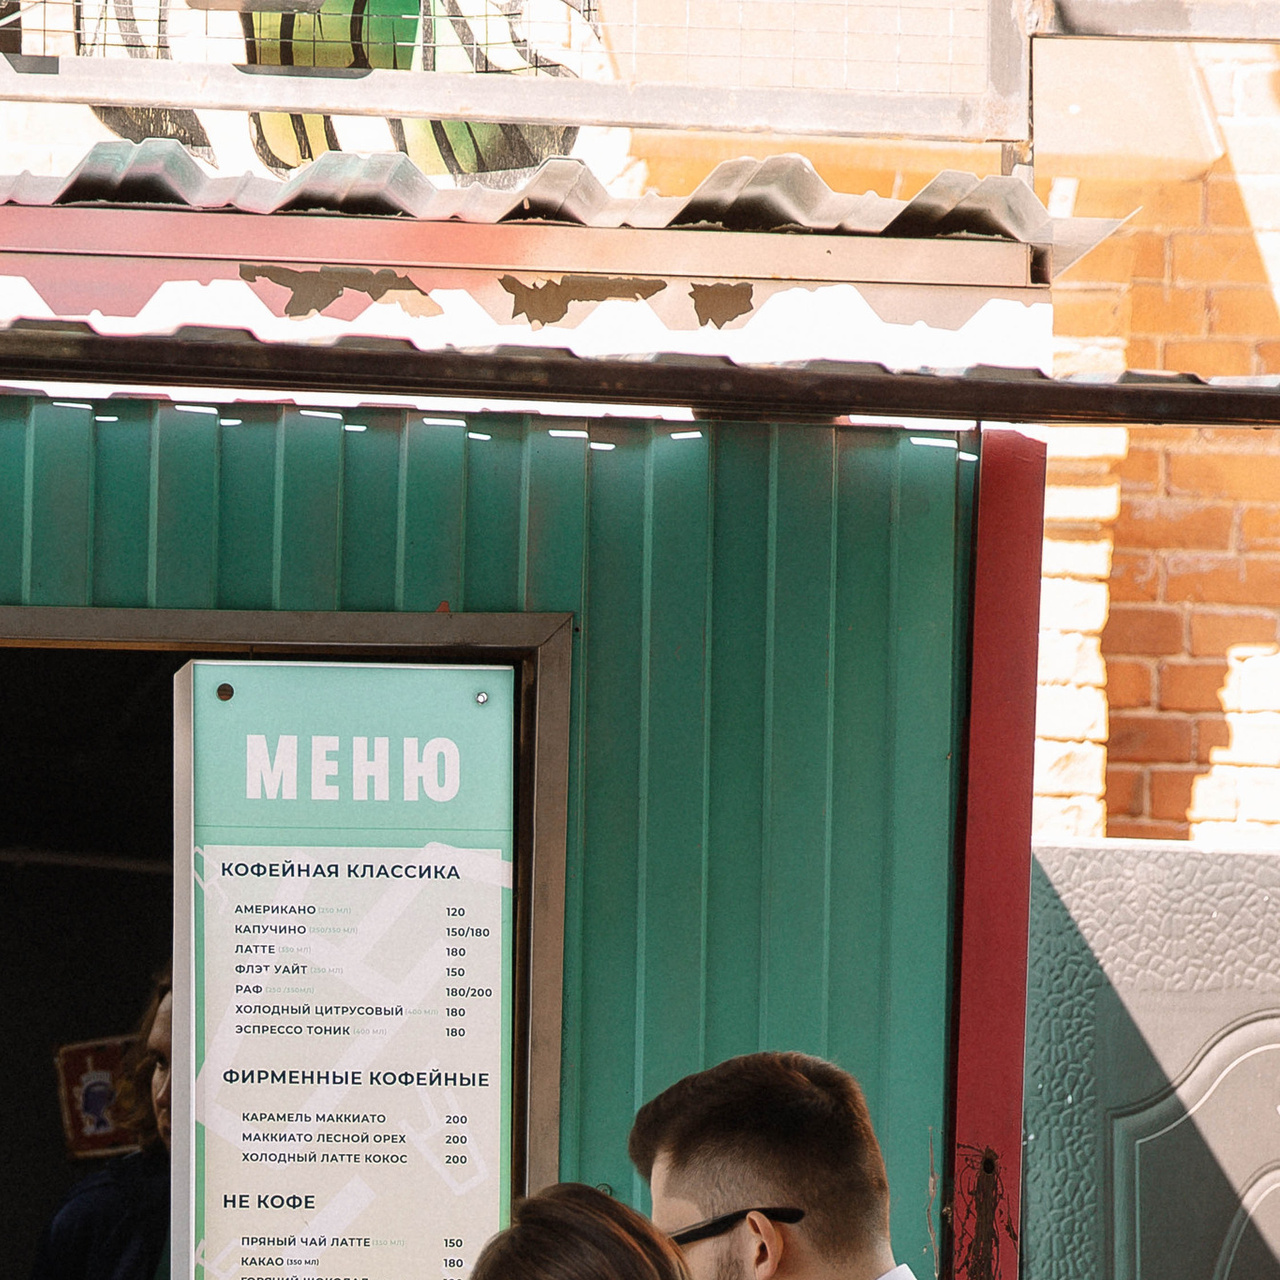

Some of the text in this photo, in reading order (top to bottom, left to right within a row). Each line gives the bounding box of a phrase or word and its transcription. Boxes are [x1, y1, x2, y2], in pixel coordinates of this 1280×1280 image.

[246, 735, 460, 802] МЕНЮ
[222, 860, 460, 879] КОФЕЙНАЯ КЛАССИКА
[234, 904, 316, 915] АМЕРИКАНО
[446, 907, 466, 917] 120
[234, 924, 307, 935] КАПУЧИНО
[446, 926, 490, 938] 150/180
[234, 944, 276, 954] ЛАТТЕ
[445, 947, 466, 957] 180
[234, 964, 271, 974] ФЛЭТ
[274, 962, 308, 975] УАЙТ
[445, 967, 465, 977] 150
[235, 984, 263, 994] РАФ
[445, 986, 493, 998] 180/200
[235, 1003, 311, 1016] ХОЛОДНЫЙ
[315, 1005, 403, 1017] ЦИТРУСОВЫЙ
[445, 1007, 466, 1017] 180
[235, 1024, 303, 1035] ЭСПРЕССО
[306, 1025, 350, 1036] ТОНИК
[445, 1027, 466, 1037] 180
[223, 1069, 488, 1086] ФИРМЕННЫЕ КОФЕЙНЫЕ
[242, 1112, 468, 1125] КАРАМЕЛЬ МАККИАТО 200
[242, 1132, 468, 1145] МАККИАТО ЛЕСНОЙ ОРЕХ 200
[241, 1152, 468, 1165] ХОЛОДНЫЙ ЛАТТЕ КОКОС 200
[224, 1195, 314, 1209] НЕ КОФЕ
[241, 1234, 296, 1247] ПРЯНЫЙ
[300, 1235, 327, 1247] ЧАЙ
[330, 1237, 371, 1247] ЛАТТЕ
[443, 1238, 463, 1248] 150
[241, 1256, 284, 1267] КАКАО
[286, 1258, 303, 1266] (350
[443, 1258, 464, 1268] 180
